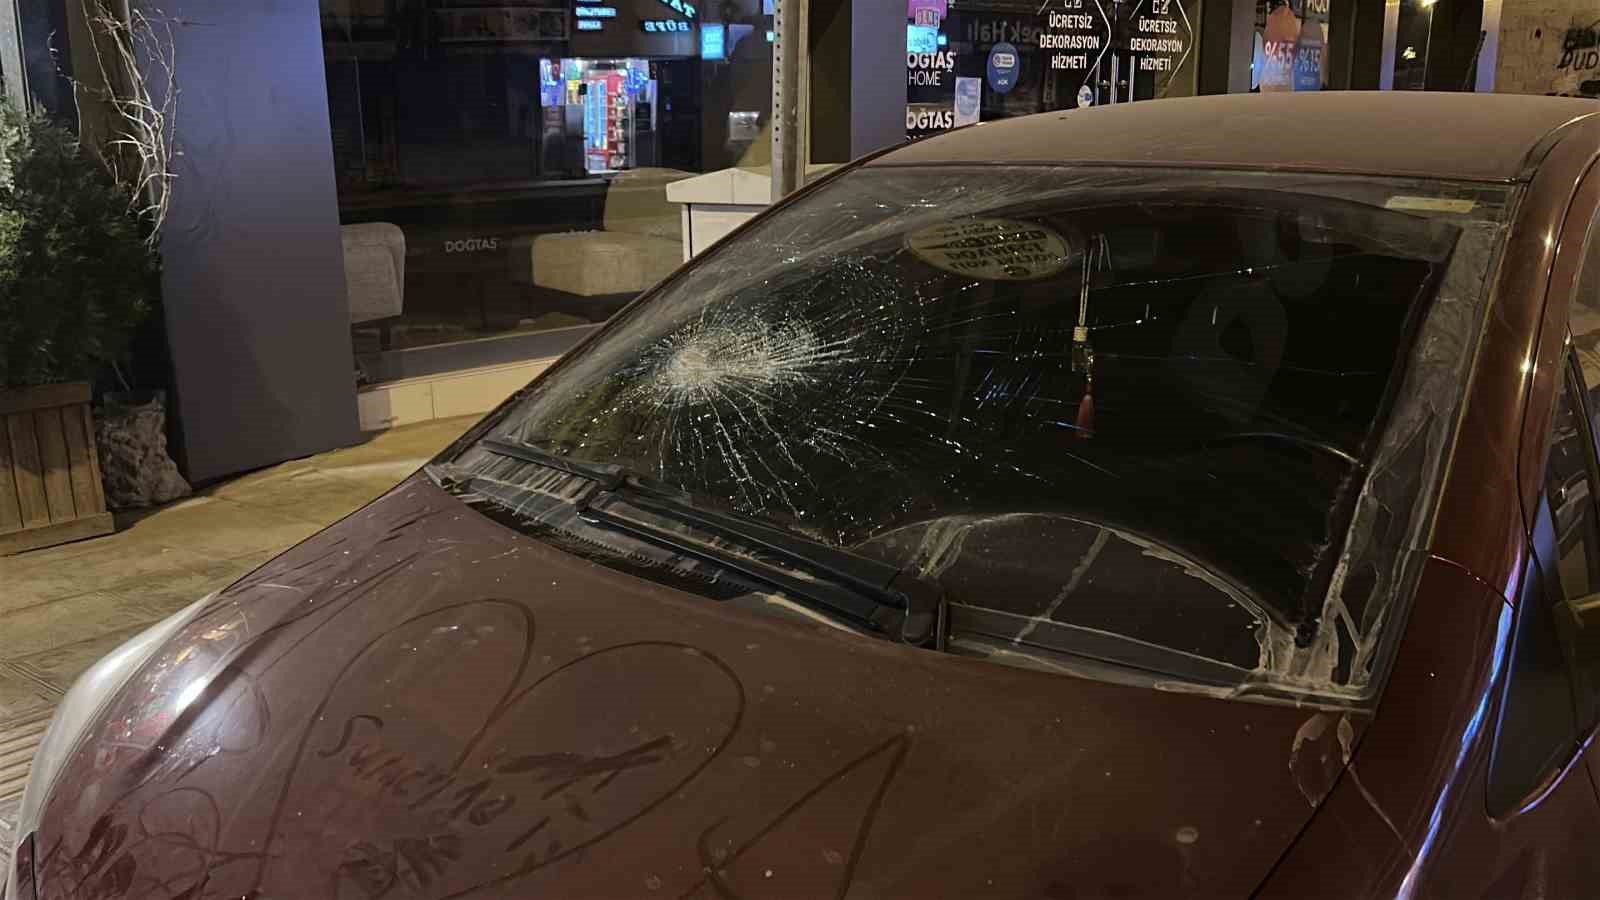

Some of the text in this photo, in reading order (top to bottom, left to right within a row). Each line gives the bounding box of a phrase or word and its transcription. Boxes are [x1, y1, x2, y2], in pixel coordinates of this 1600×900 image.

[1049, 11, 1093, 29] ÜCRETSİZ
[1139, 16, 1177, 34] ÜCRETSİZ
[1040, 35, 1100, 49] DEKORASYON
[1130, 38, 1183, 53] DEKORASYON
[1051, 52, 1087, 69] HİZMETİ
[1140, 55, 1172, 71] HİZMETİ
[908, 71, 942, 86] HOME
